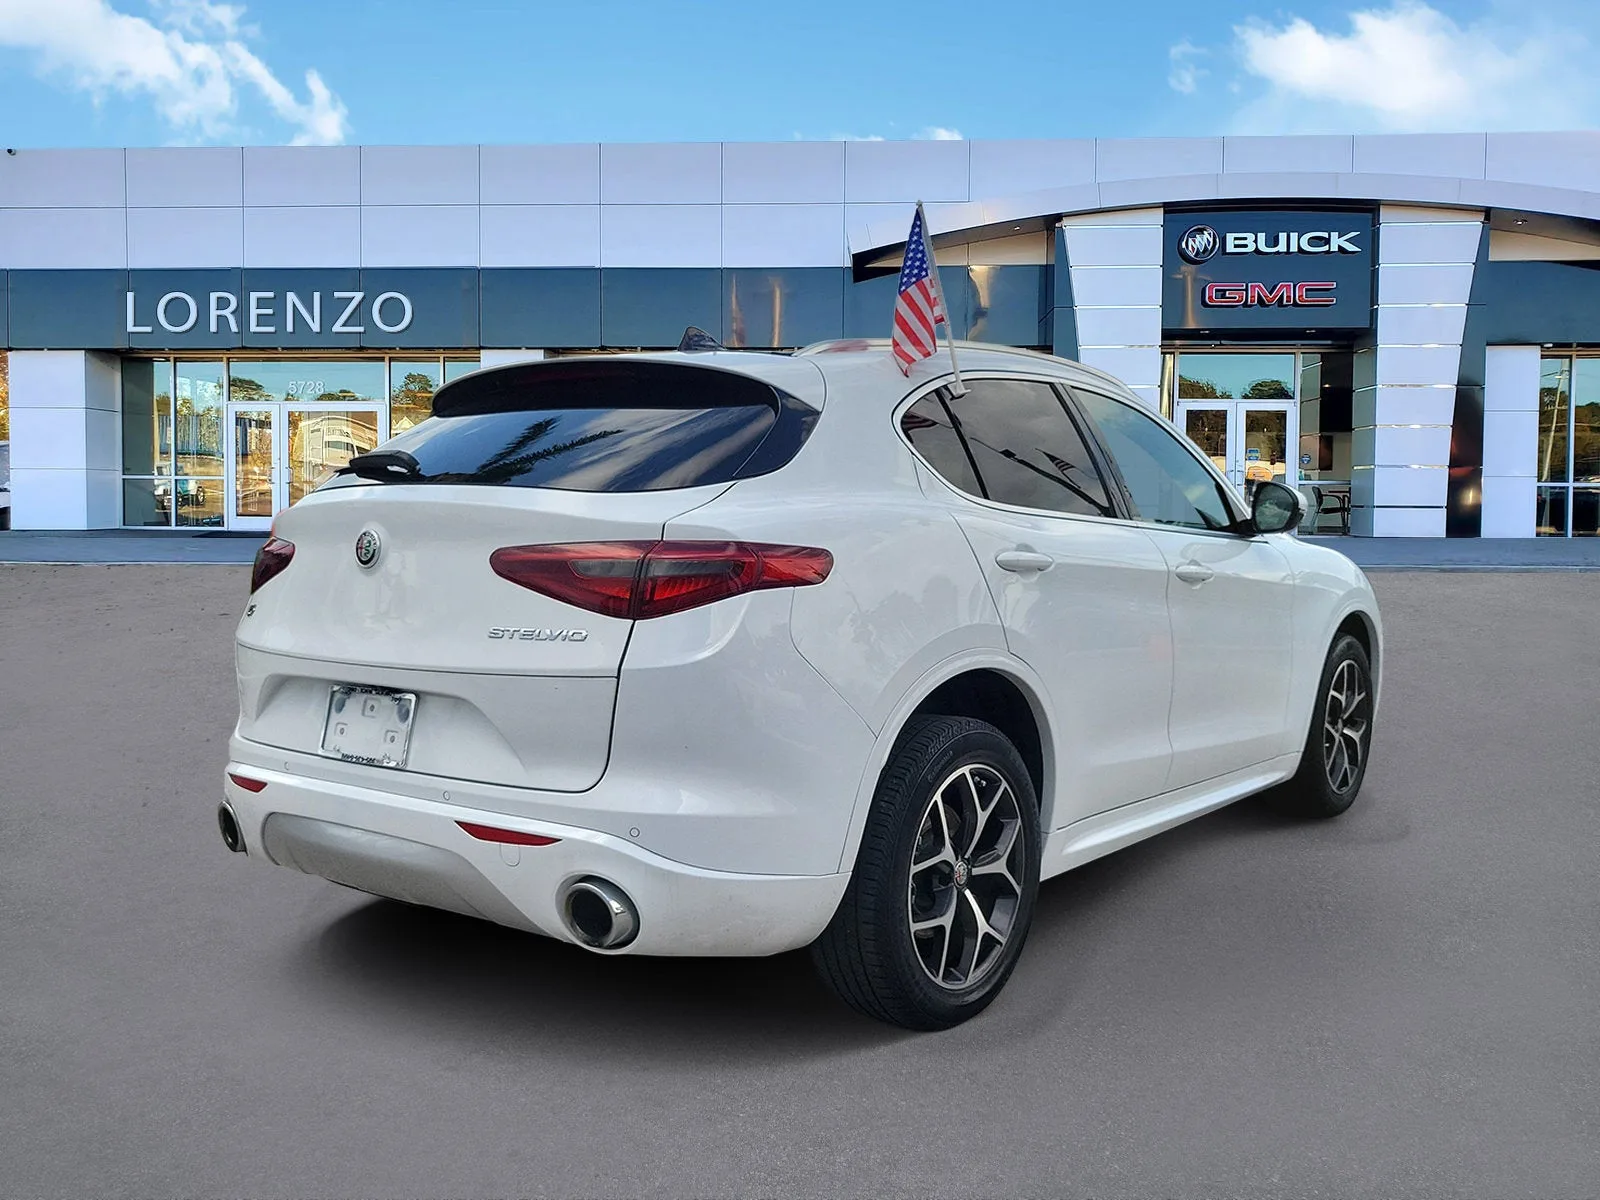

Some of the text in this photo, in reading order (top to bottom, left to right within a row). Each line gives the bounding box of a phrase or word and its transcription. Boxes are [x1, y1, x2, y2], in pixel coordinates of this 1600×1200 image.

[1225, 231, 1361, 253] BUICK
[1206, 282, 1336, 305] GMC
[126, 291, 413, 333] LORENZO
[288, 381, 325, 394] 5728
[488, 626, 588, 642] STELVIO
